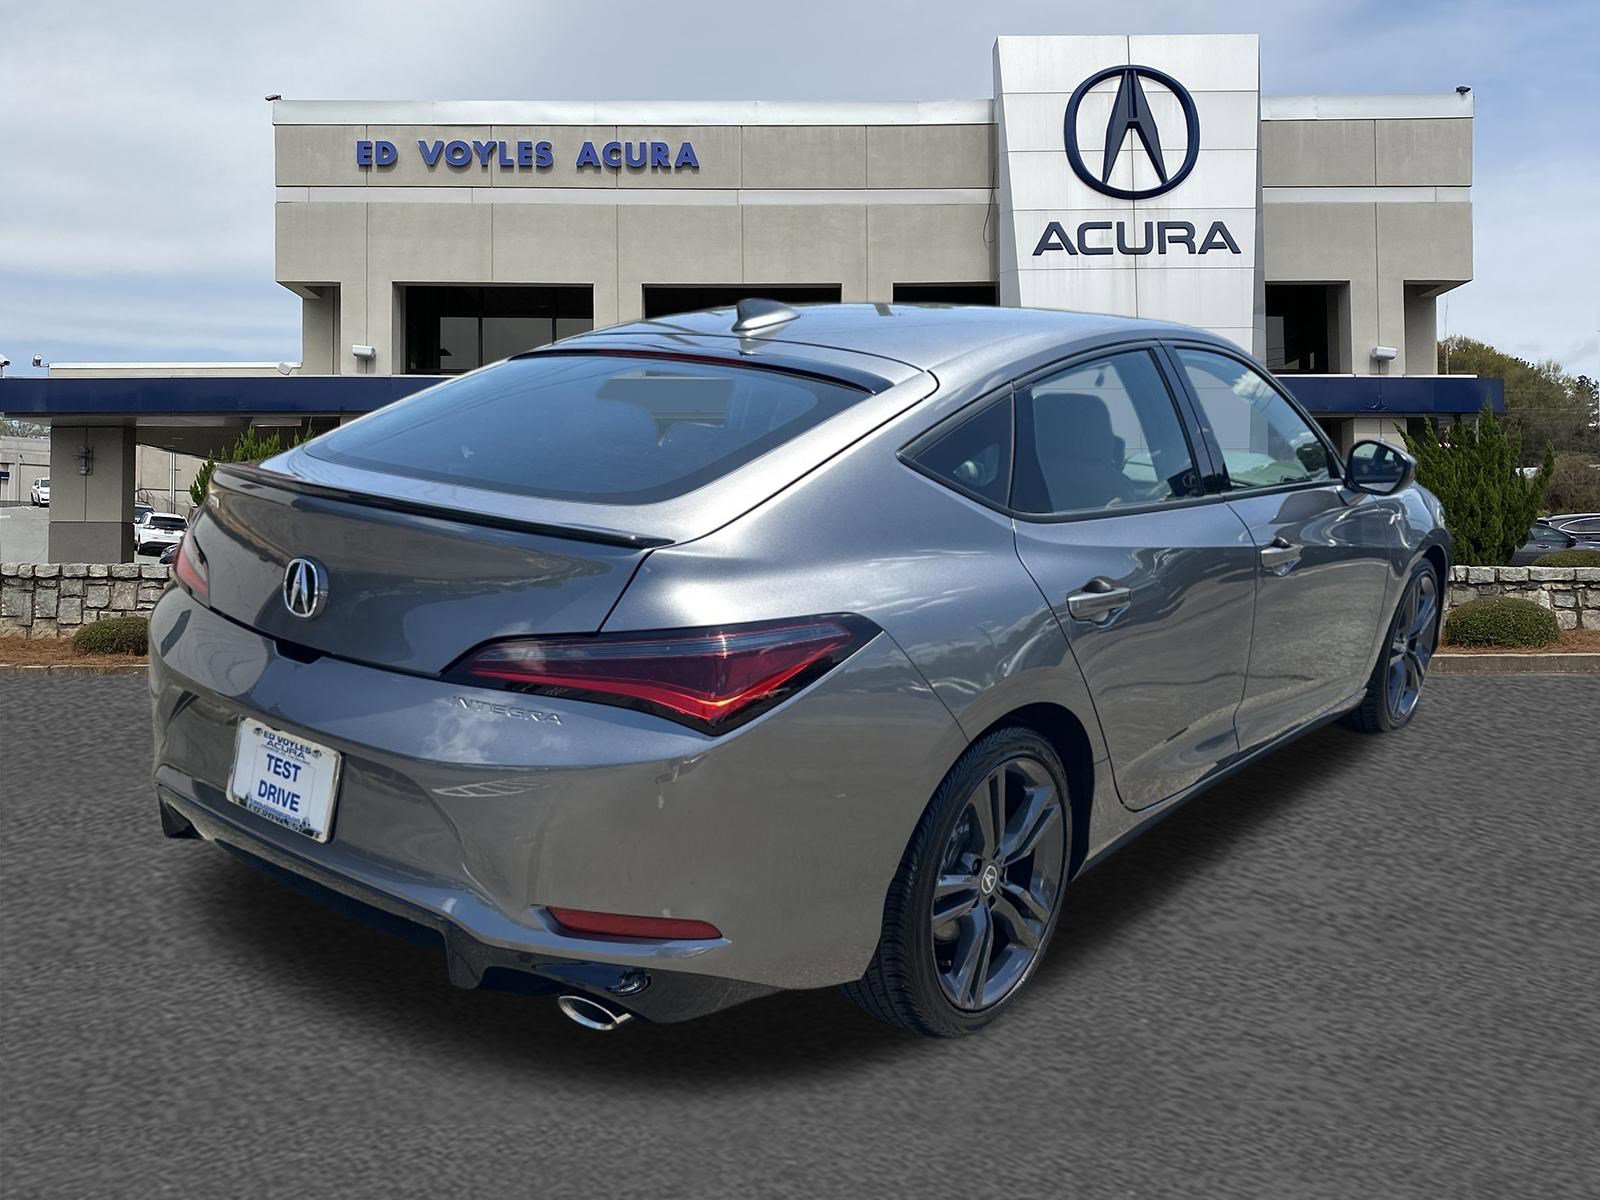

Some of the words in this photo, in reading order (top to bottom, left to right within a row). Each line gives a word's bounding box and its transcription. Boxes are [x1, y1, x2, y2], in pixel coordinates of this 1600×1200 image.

[356, 140, 398, 167] ED
[418, 140, 554, 168] VOYLES
[576, 141, 700, 168] ACURA
[1032, 221, 1242, 256] ACURA
[263, 730, 275, 741] ED
[277, 735, 312, 755] VOYLES
[266, 740, 306, 760] ACURA
[266, 753, 302, 783] TEST
[258, 779, 301, 813] DRIVE
